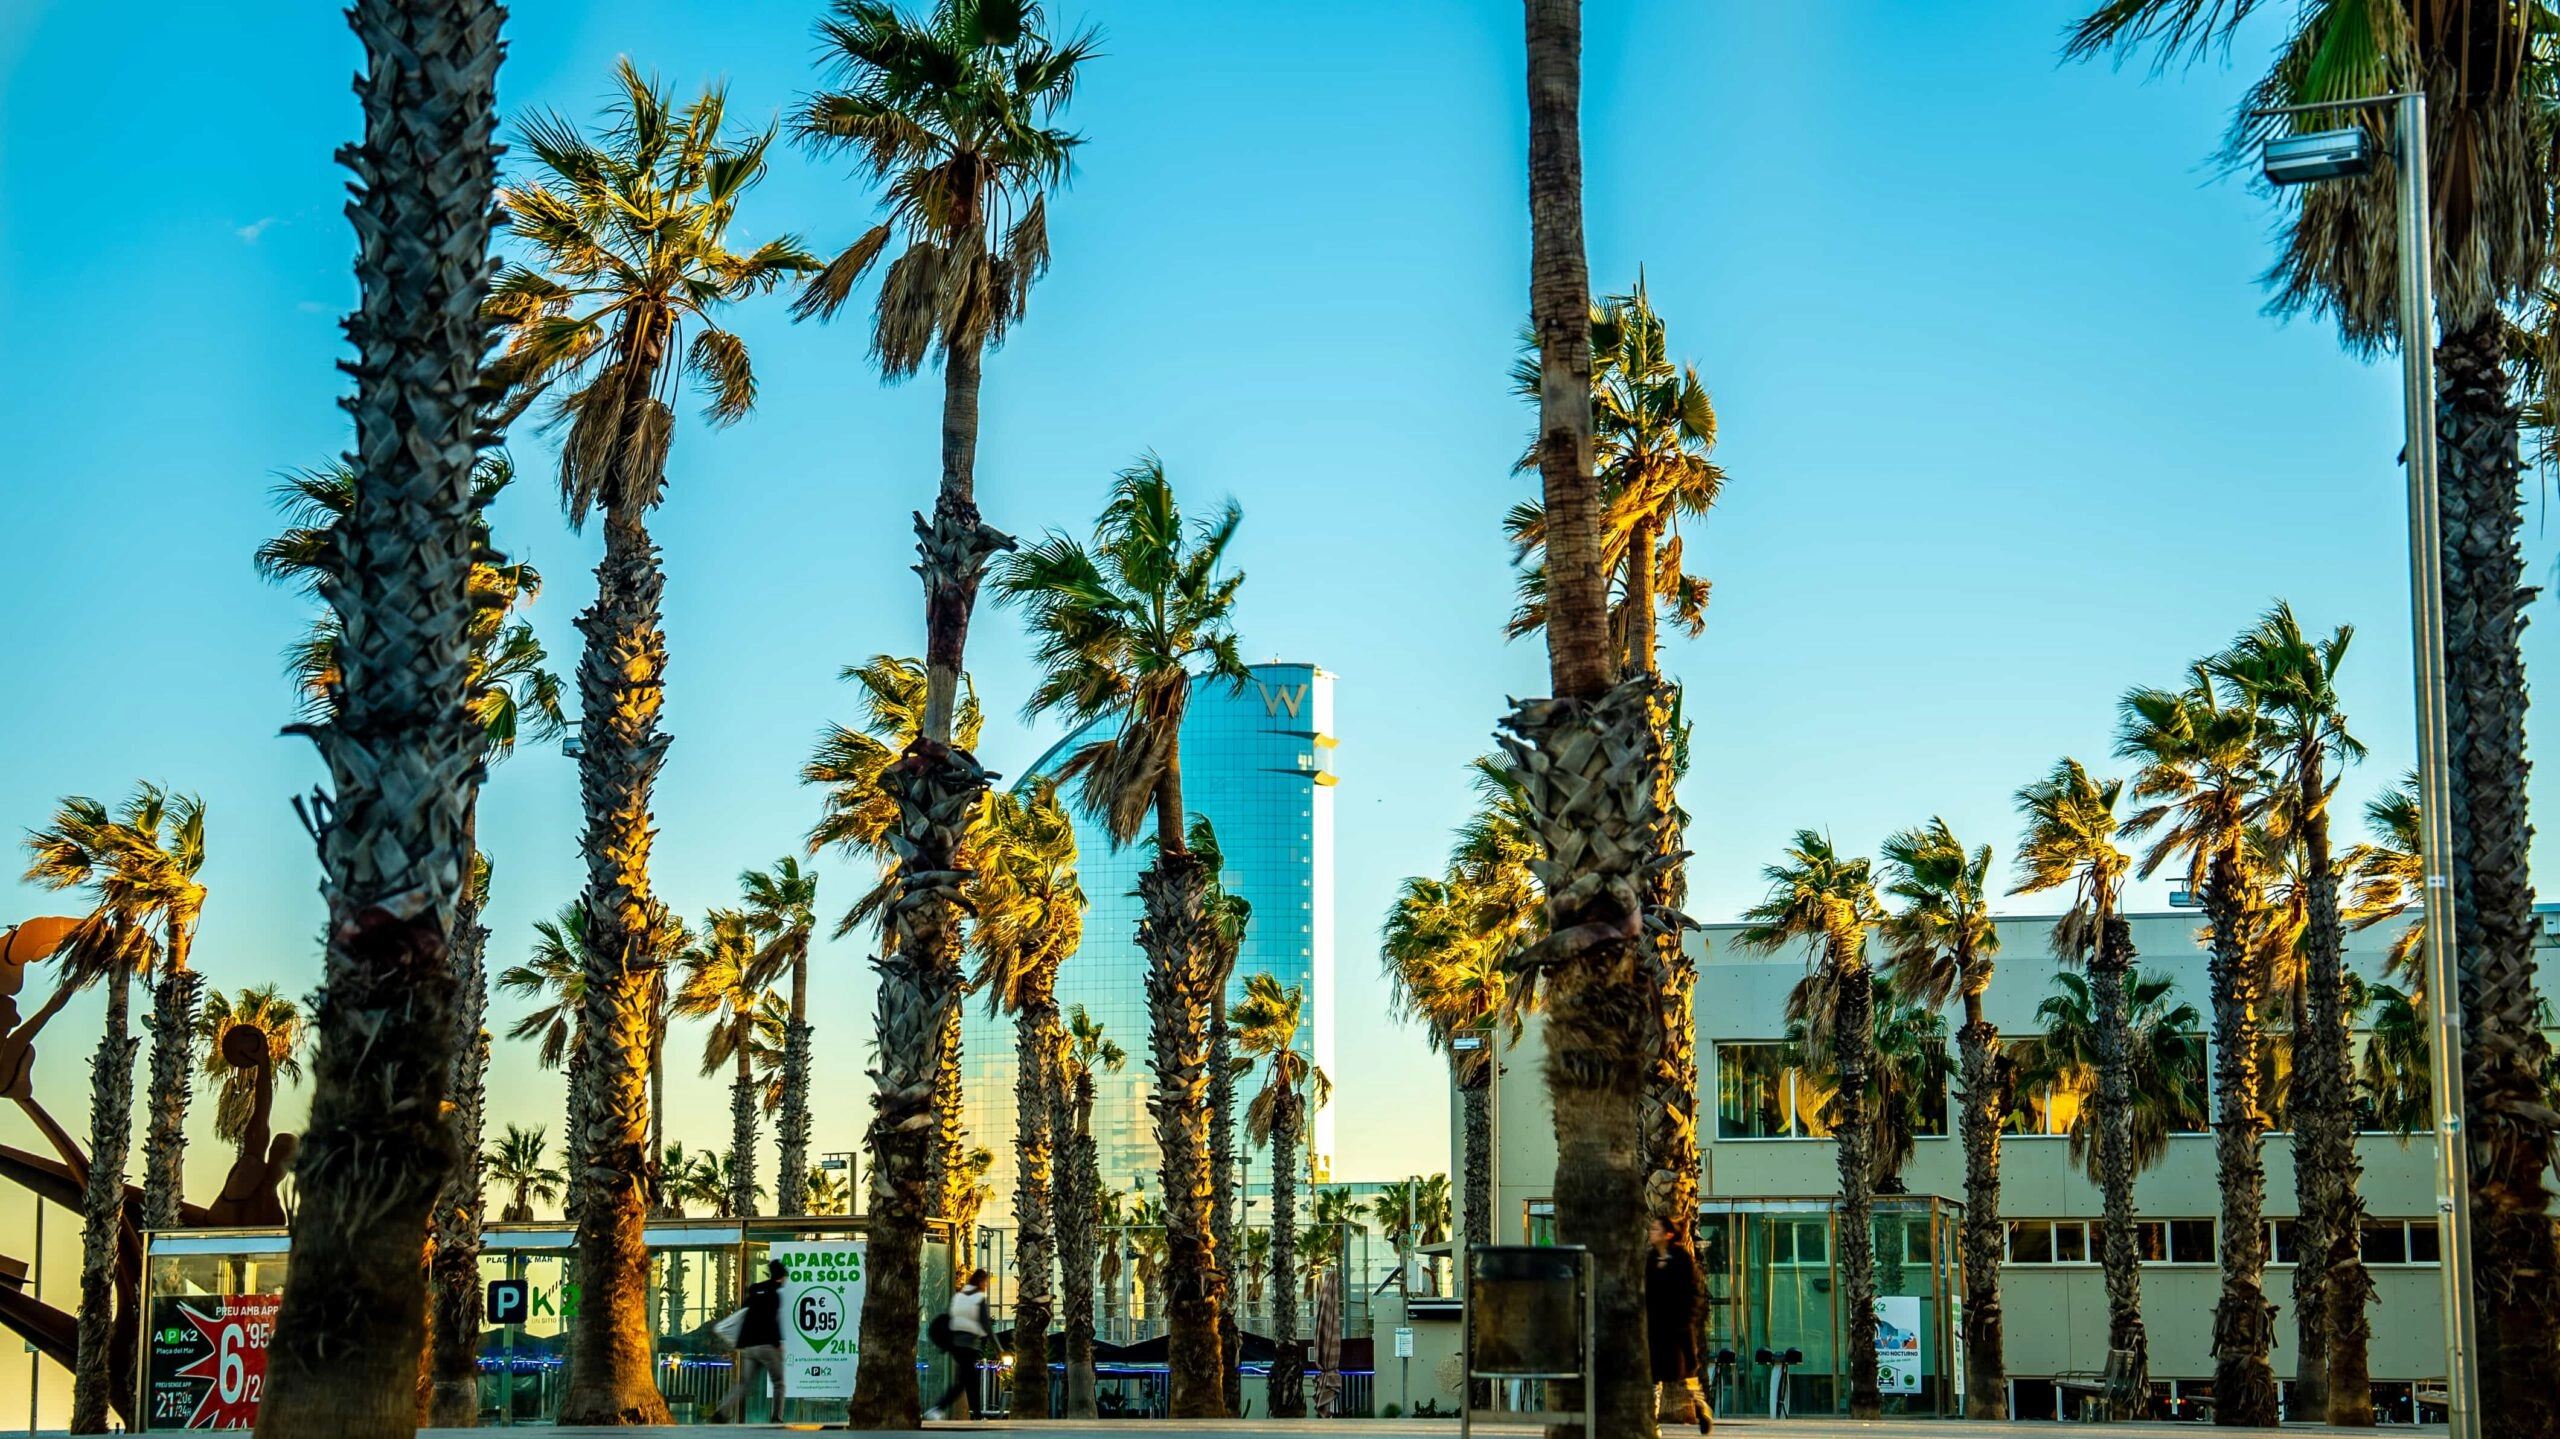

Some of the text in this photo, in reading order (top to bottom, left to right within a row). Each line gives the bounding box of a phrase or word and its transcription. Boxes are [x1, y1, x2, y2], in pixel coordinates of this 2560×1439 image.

[1258, 683, 1308, 719] W
[782, 1252, 860, 1267] APARCA
[786, 1266, 860, 1282] OR SÓLO
[216, 1306, 279, 1316] PREU AMB APP
